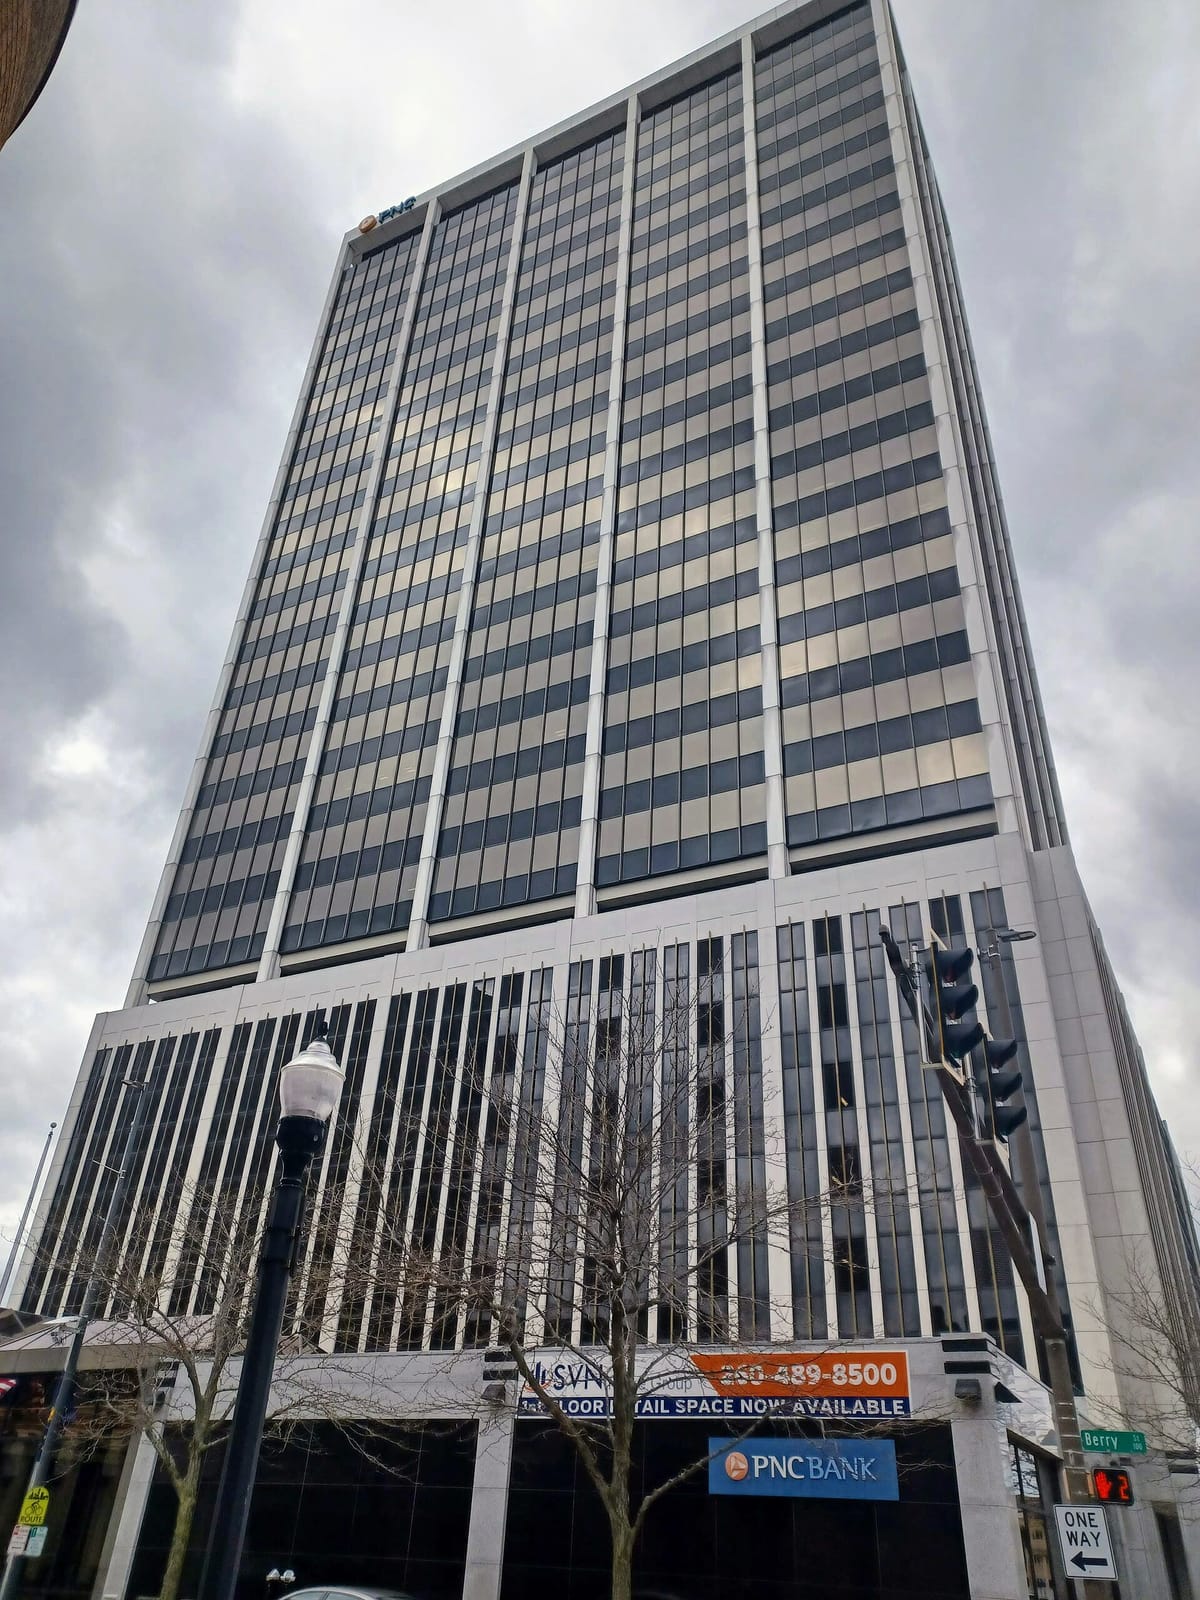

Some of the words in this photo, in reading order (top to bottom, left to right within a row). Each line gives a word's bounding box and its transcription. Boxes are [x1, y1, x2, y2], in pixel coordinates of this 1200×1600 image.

[378, 196, 416, 224] PNC
[553, 1364, 603, 1391] SVN
[651, 1376, 693, 1393] Group
[720, 1363, 897, 1386] 260-489-8500
[553, 1400, 604, 1414] LOOR
[609, 1399, 670, 1414] TAIL
[675, 1399, 735, 1414] SPACE
[740, 1398, 786, 1414] NOW
[793, 1400, 905, 1415] AVAILABLE
[1085, 1432, 1118, 1450] Berry
[1064, 1511, 1099, 1528] ONE
[1065, 1530, 1101, 1548] WAY
